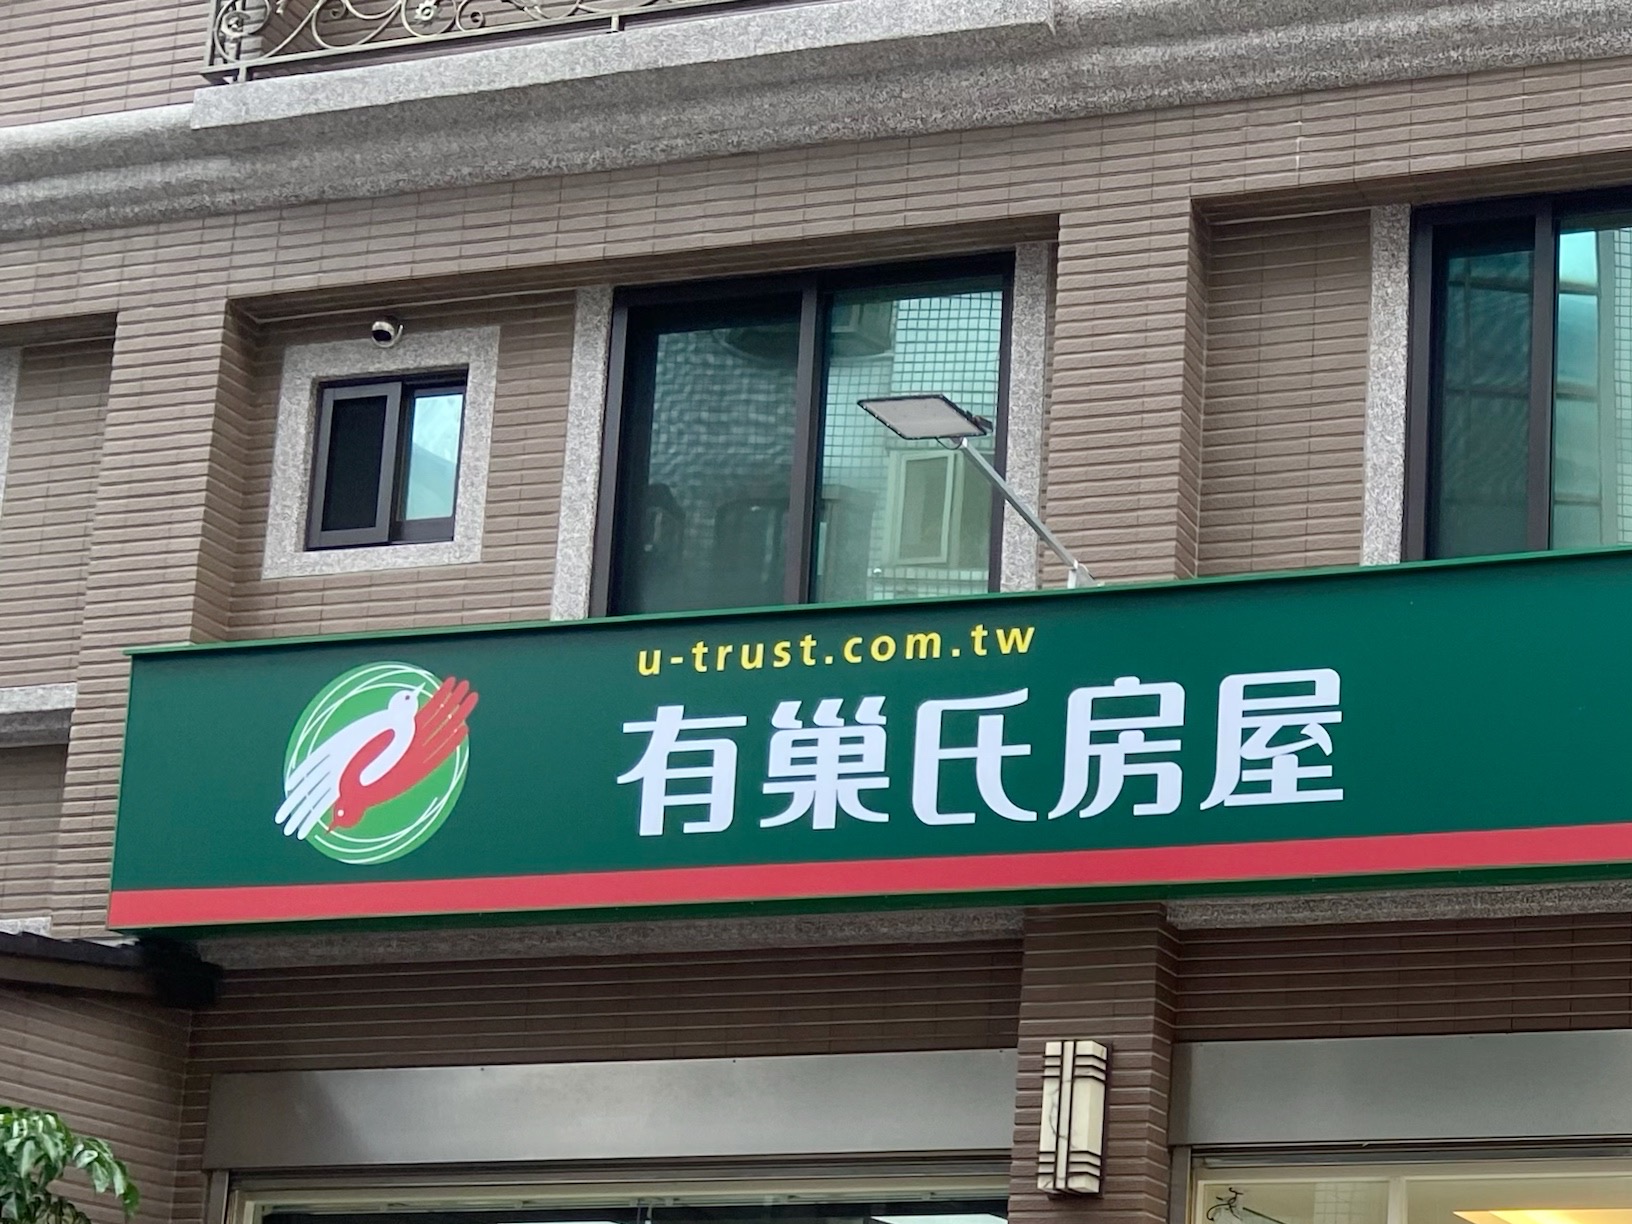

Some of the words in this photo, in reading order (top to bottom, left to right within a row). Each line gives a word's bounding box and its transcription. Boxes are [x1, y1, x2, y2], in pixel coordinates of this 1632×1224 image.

[637, 624, 1035, 676] u-trust.com.tw
[617, 667, 1344, 836] 有巢氏房屋
